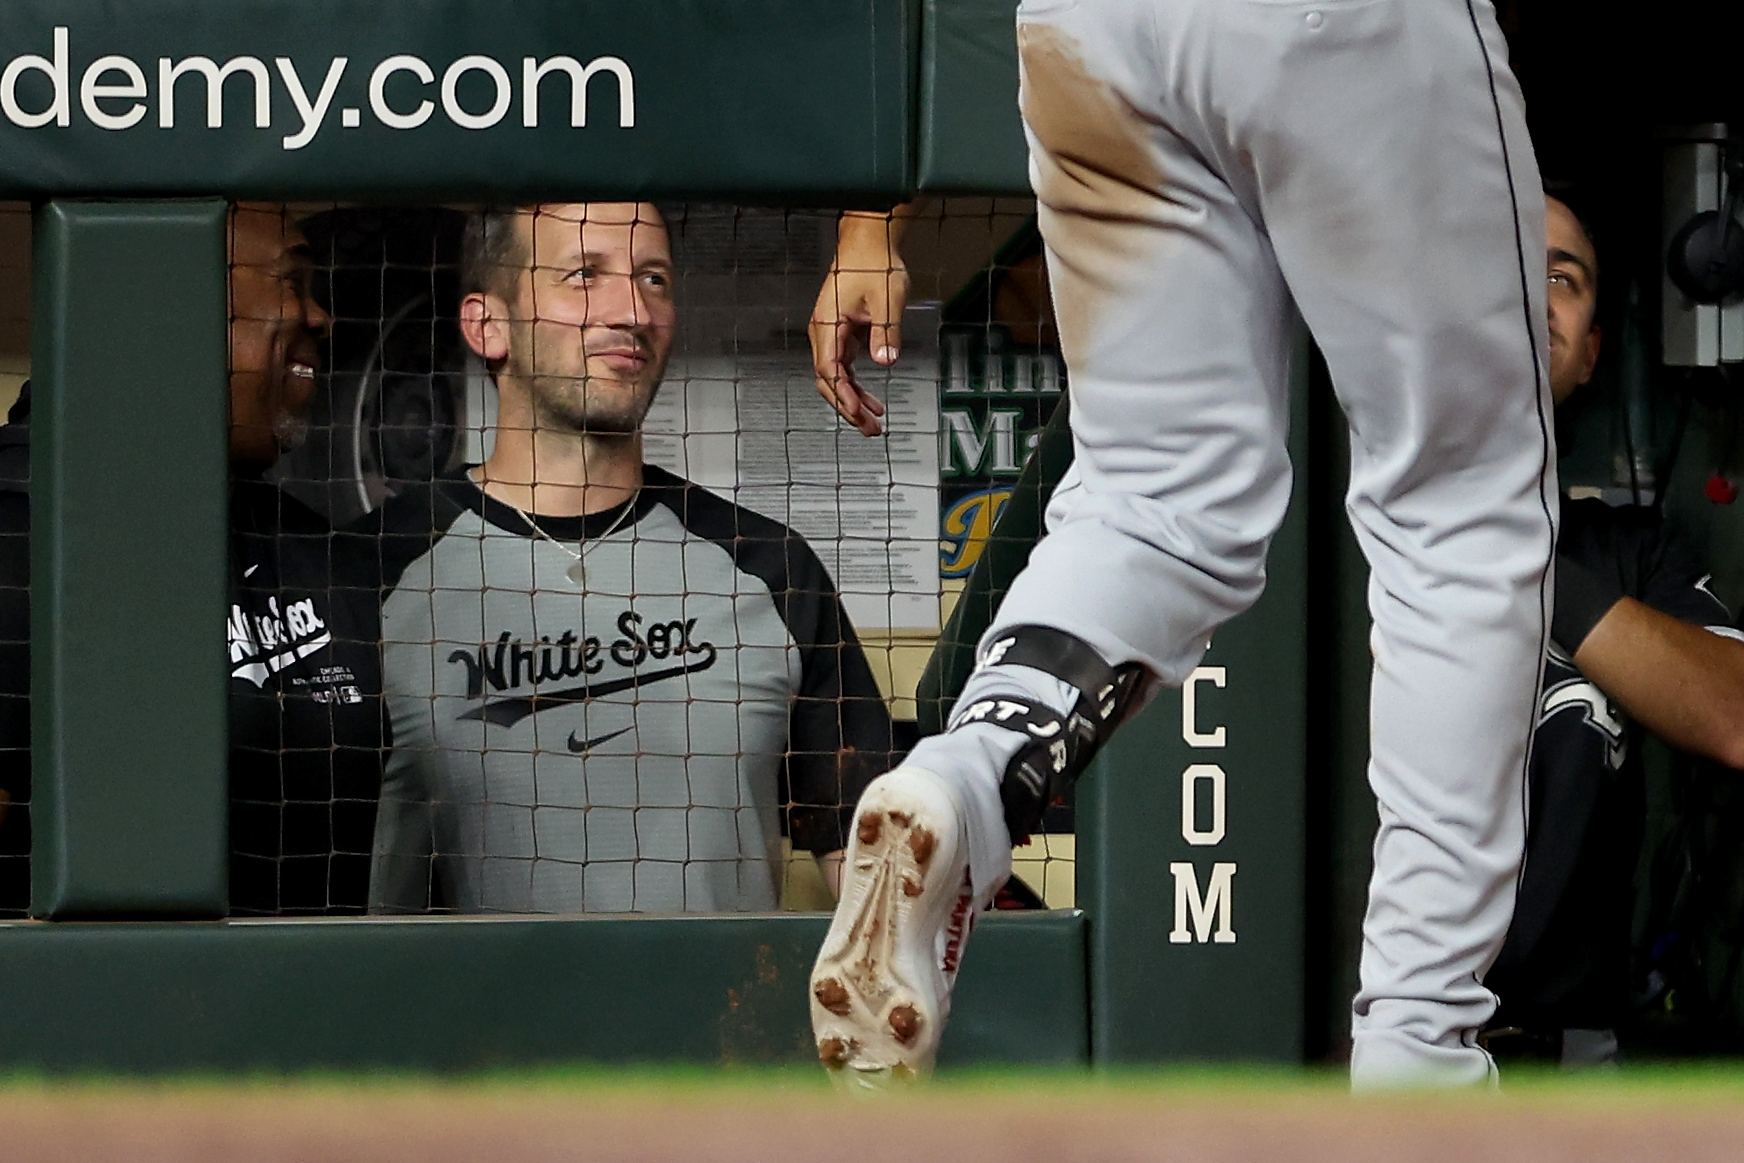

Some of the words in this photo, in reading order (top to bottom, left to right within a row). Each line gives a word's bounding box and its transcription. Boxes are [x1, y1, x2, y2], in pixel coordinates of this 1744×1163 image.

[0, 26, 635, 150] demy.com
[447, 631, 605, 700] White
[610, 611, 702, 667] Sox
